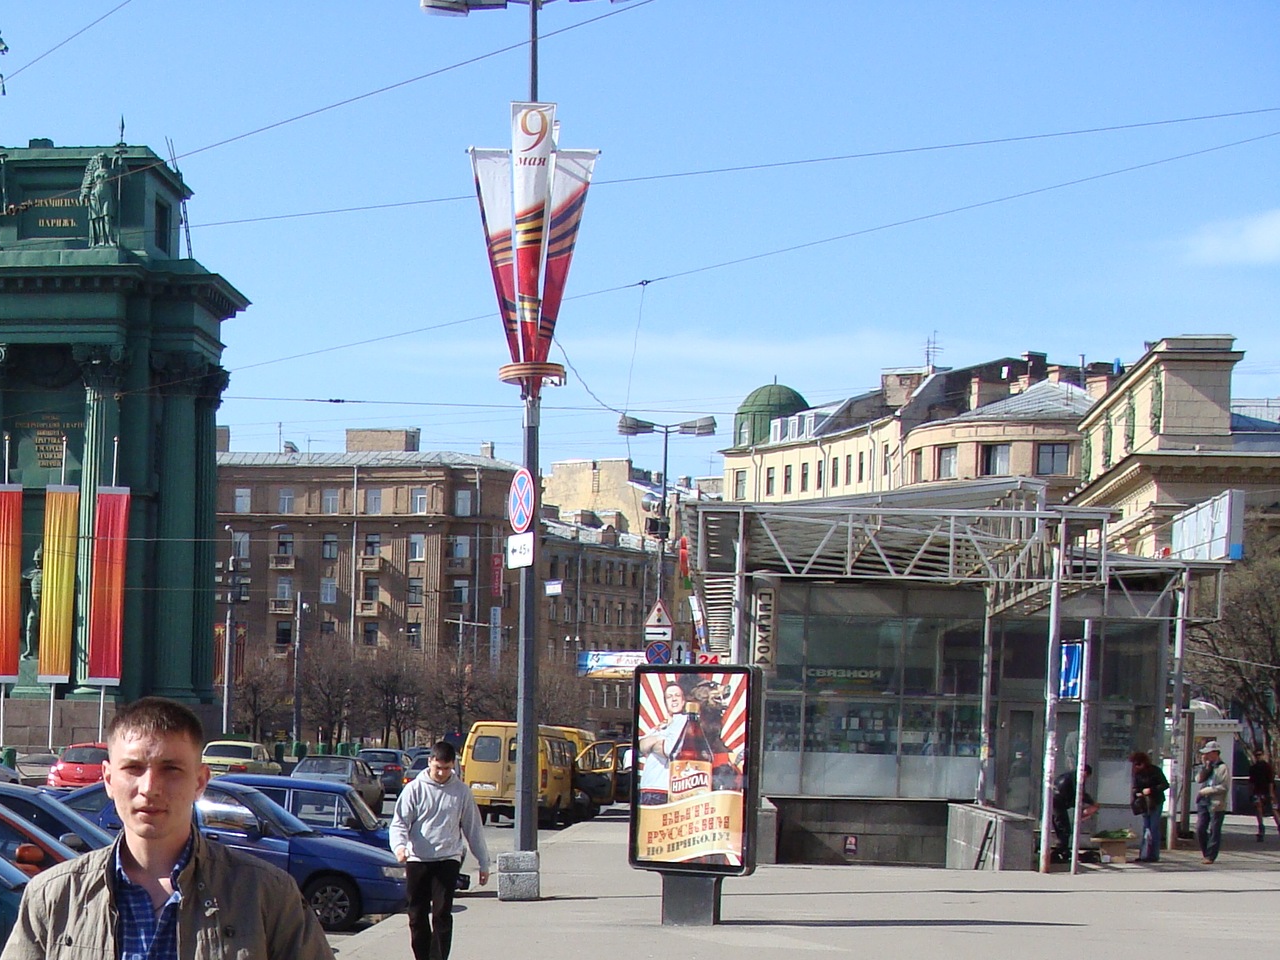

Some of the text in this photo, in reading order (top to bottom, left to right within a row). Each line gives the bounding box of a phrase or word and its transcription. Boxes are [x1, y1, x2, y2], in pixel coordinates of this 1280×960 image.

[520, 107, 548, 152] 9
[515, 155, 547, 167] мая
[755, 592, 772, 665] ПЕРЕХОД
[698, 654, 719, 665] 24
[661, 802, 716, 828] БЫТЬ
[647, 815, 731, 845] РУССКИМ
[646, 831, 731, 857] ПО ПРИКОЛУ!
